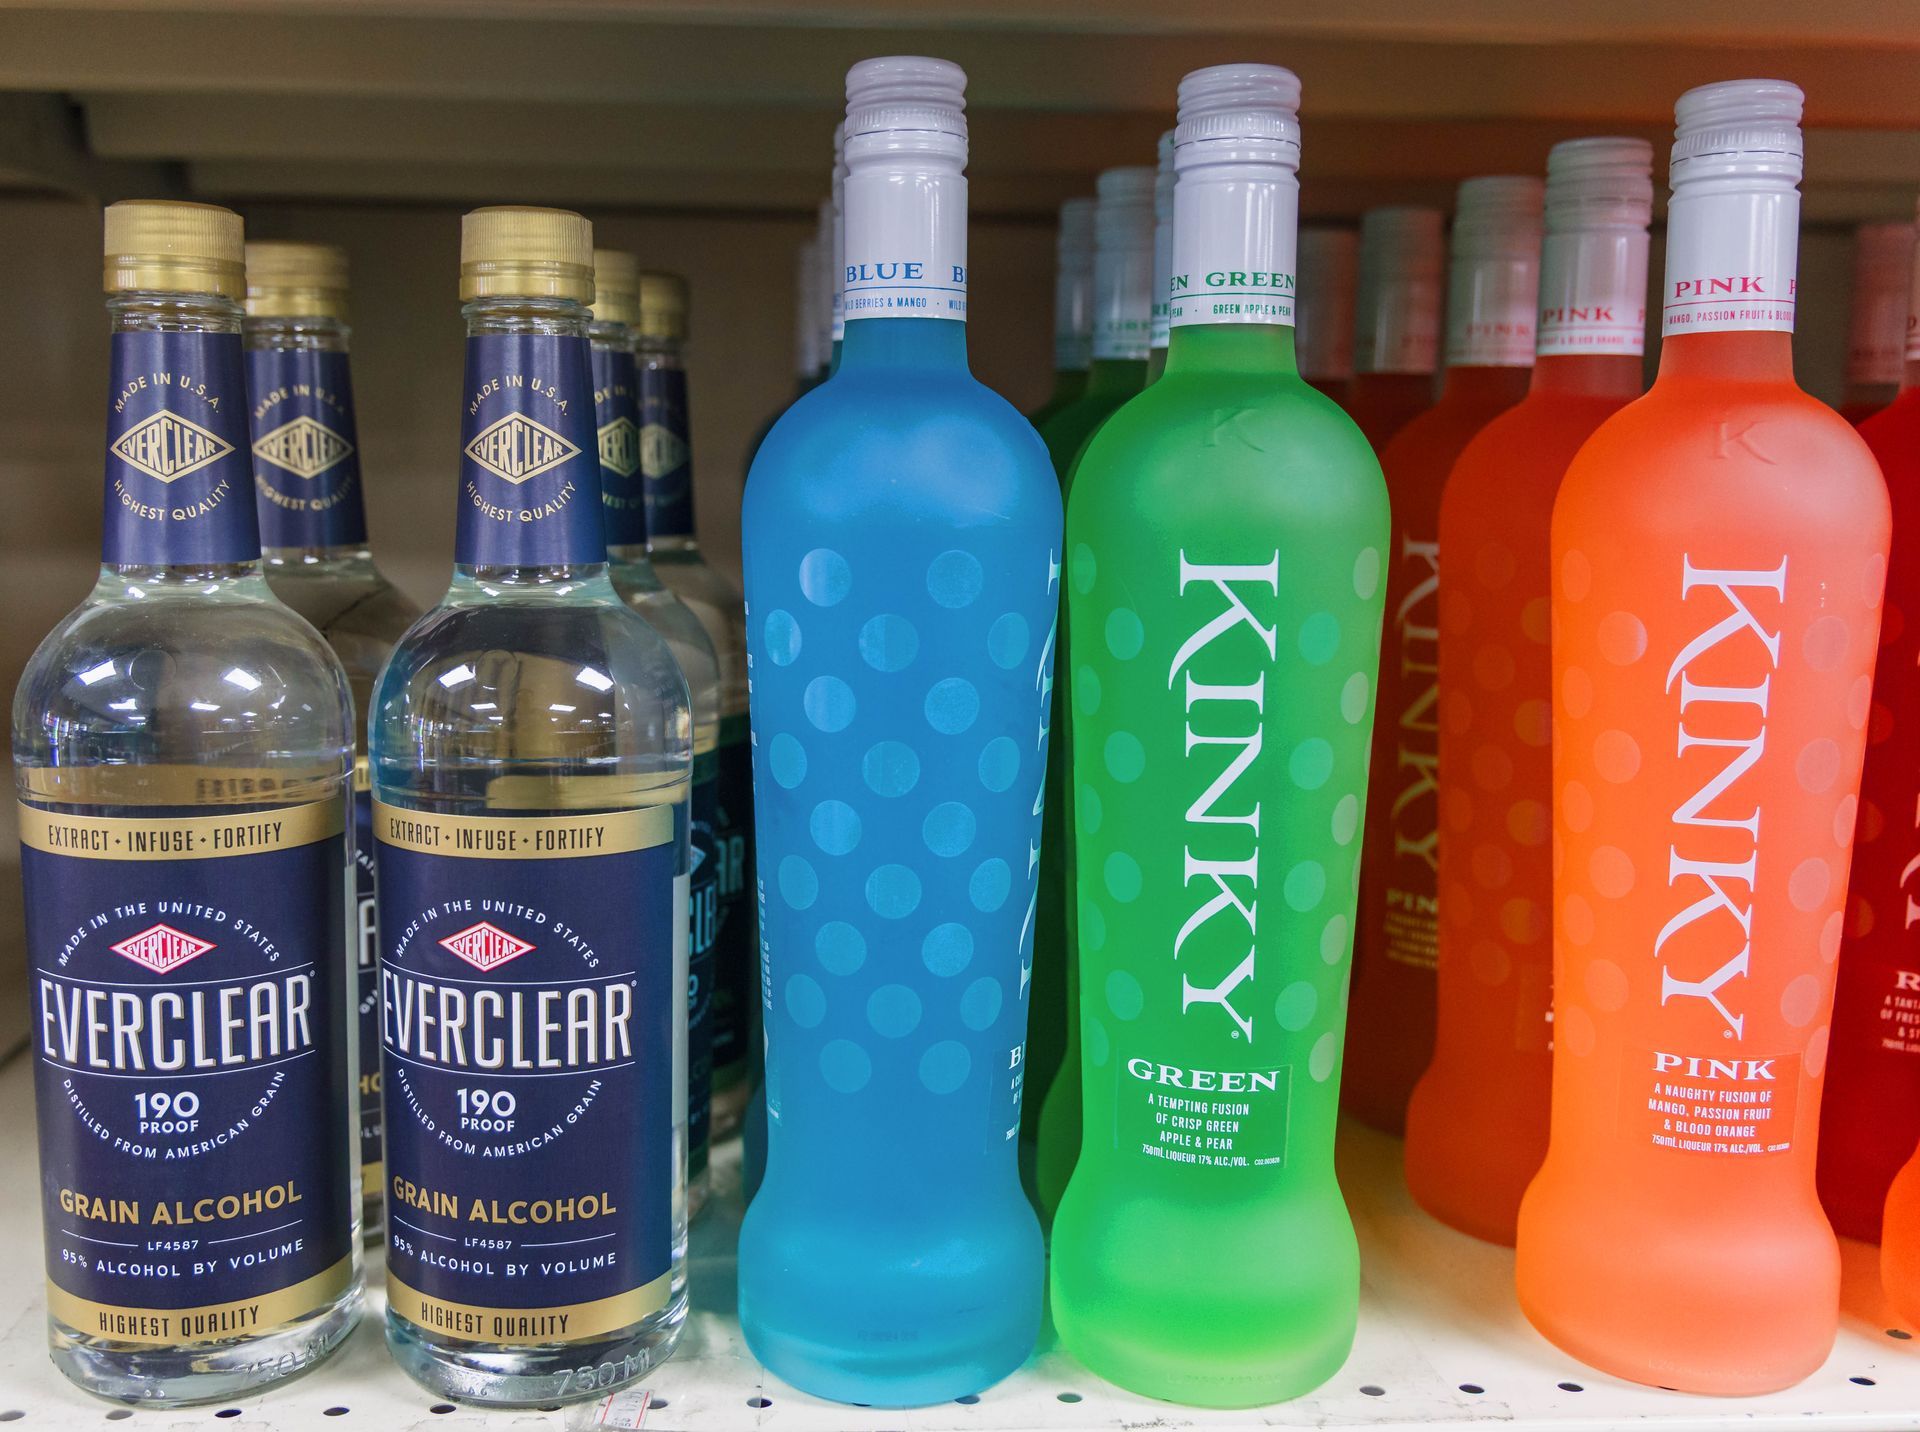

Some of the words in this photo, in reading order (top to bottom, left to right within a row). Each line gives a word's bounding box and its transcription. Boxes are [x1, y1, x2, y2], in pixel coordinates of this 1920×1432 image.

[846, 262, 923, 283] BLUE
[1206, 271, 1295, 289] GREEN
[1674, 277, 1766, 298] PINK
[855, 297, 884, 308] BERRIES
[887, 297, 893, 307] &
[896, 297, 927, 307] MANGO
[1213, 304, 1240, 315] GREEN
[1244, 304, 1269, 315] APPLE
[1542, 306, 1613, 324] PINK
[1697, 310, 1735, 322] PASSION
[1740, 310, 1765, 320] FRUIT
[115, 375, 147, 414] MADE
[153, 372, 172, 386] IN
[180, 375, 221, 414] U.S.A.
[469, 379, 500, 415] MADE
[506, 376, 522, 388] IN
[531, 377, 569, 415] U.S.A.
[121, 417, 217, 476] EVERCLEAR
[474, 419, 564, 478] EVERCLEAR
[114, 479, 165, 521] HIGHEST
[172, 479, 231, 521] QUALITY
[466, 480, 513, 522] HIGHEST
[520, 480, 576, 522] QUALITY
[1168, 548, 1279, 1044] KINKY
[1654, 552, 1788, 1041] KINKY
[49, 825, 109, 851] EXTRACT
[128, 830, 194, 852] INFUSE
[214, 822, 282, 849] FORTIFY
[390, 818, 440, 847] EXTRACT
[456, 828, 516, 850] INFUSE
[536, 826, 604, 850] FORTIFY
[1386, 886, 1439, 914] PIN
[58, 927, 88, 966] MADE
[91, 913, 108, 929] IN
[115, 902, 147, 918] THE
[159, 901, 227, 922] UNITED
[235, 919, 279, 962] STATES
[396, 923, 419, 958] MADE
[422, 908, 438, 923] IN
[443, 899, 472, 914] THE
[483, 899, 546, 924] UNITED
[554, 922, 599, 968] STATES
[453, 928, 518, 967] EVERCLEAR
[127, 930, 197, 967] EVERCLEAR
[1127, 1058, 1280, 1093] GREEN
[1653, 1052, 1776, 1080] PINK
[135, 1091, 200, 1118] 190
[457, 1088, 516, 1117] 190
[1148, 1093, 1154, 1104] A
[1158, 1095, 1208, 1114] TEMPTING
[1212, 1103, 1249, 1115] FUSION
[1655, 1083, 1660, 1093] A
[1665, 1085, 1715, 1101] NAUGHTY
[1719, 1091, 1756, 1103] FUSION
[1760, 1091, 1772, 1102] OF
[64, 1078, 109, 1139] DISTILLED
[115, 1137, 157, 1158] FROM
[165, 1118, 249, 1159] AMERICAN
[252, 1071, 285, 1117] GRAIN
[140, 1119, 199, 1134] PROOF
[398, 1068, 435, 1131] DISTILLED
[439, 1130, 476, 1155] FROM
[483, 1124, 564, 1157] AMERICAN
[567, 1079, 601, 1123] GRAIN
[461, 1116, 515, 1132] PROOF
[1156, 1112, 1168, 1124] OF
[1172, 1116, 1201, 1130] CRISP
[1206, 1121, 1239, 1132] GREEN
[1694, 1106, 1739, 1120] PASSION
[1744, 1108, 1771, 1120] FRUIT
[1160, 1130, 1191, 1146] APPLE
[1195, 1137, 1201, 1148] &
[1206, 1138, 1232, 1150] PEAR
[1664, 1119, 1671, 1130] &
[1676, 1121, 1711, 1136] BLOOD
[1715, 1125, 1756, 1137] ORANGE
[1166, 1149, 1196, 1163] LIQUEUR
[1198, 1155, 1212, 1165] 17%
[1678, 1141, 1711, 1152] LIQUEUR
[1714, 1143, 1728, 1153] 17%
[60, 1188, 139, 1225] GRAIN
[152, 1180, 303, 1225] ALCOHOL
[393, 1175, 458, 1219] GRAIN
[469, 1192, 617, 1225] ALCOHOL
[62, 1248, 87, 1268] 95%
[97, 1260, 180, 1277] ALCOHOL
[194, 1260, 217, 1274] BY
[230, 1238, 304, 1269] VOLUME
[147, 1240, 199, 1251] LF4587
[394, 1234, 413, 1256] 95%
[421, 1250, 494, 1275] ALCOHOL
[506, 1263, 529, 1276] BY
[541, 1252, 616, 1275] VOLUME
[464, 1237, 512, 1250] LF4587
[100, 1311, 169, 1337] HIGHEST
[181, 1305, 260, 1337] QUALITY
[421, 1301, 483, 1335] HIGHEST
[494, 1313, 569, 1337] QUALITY
